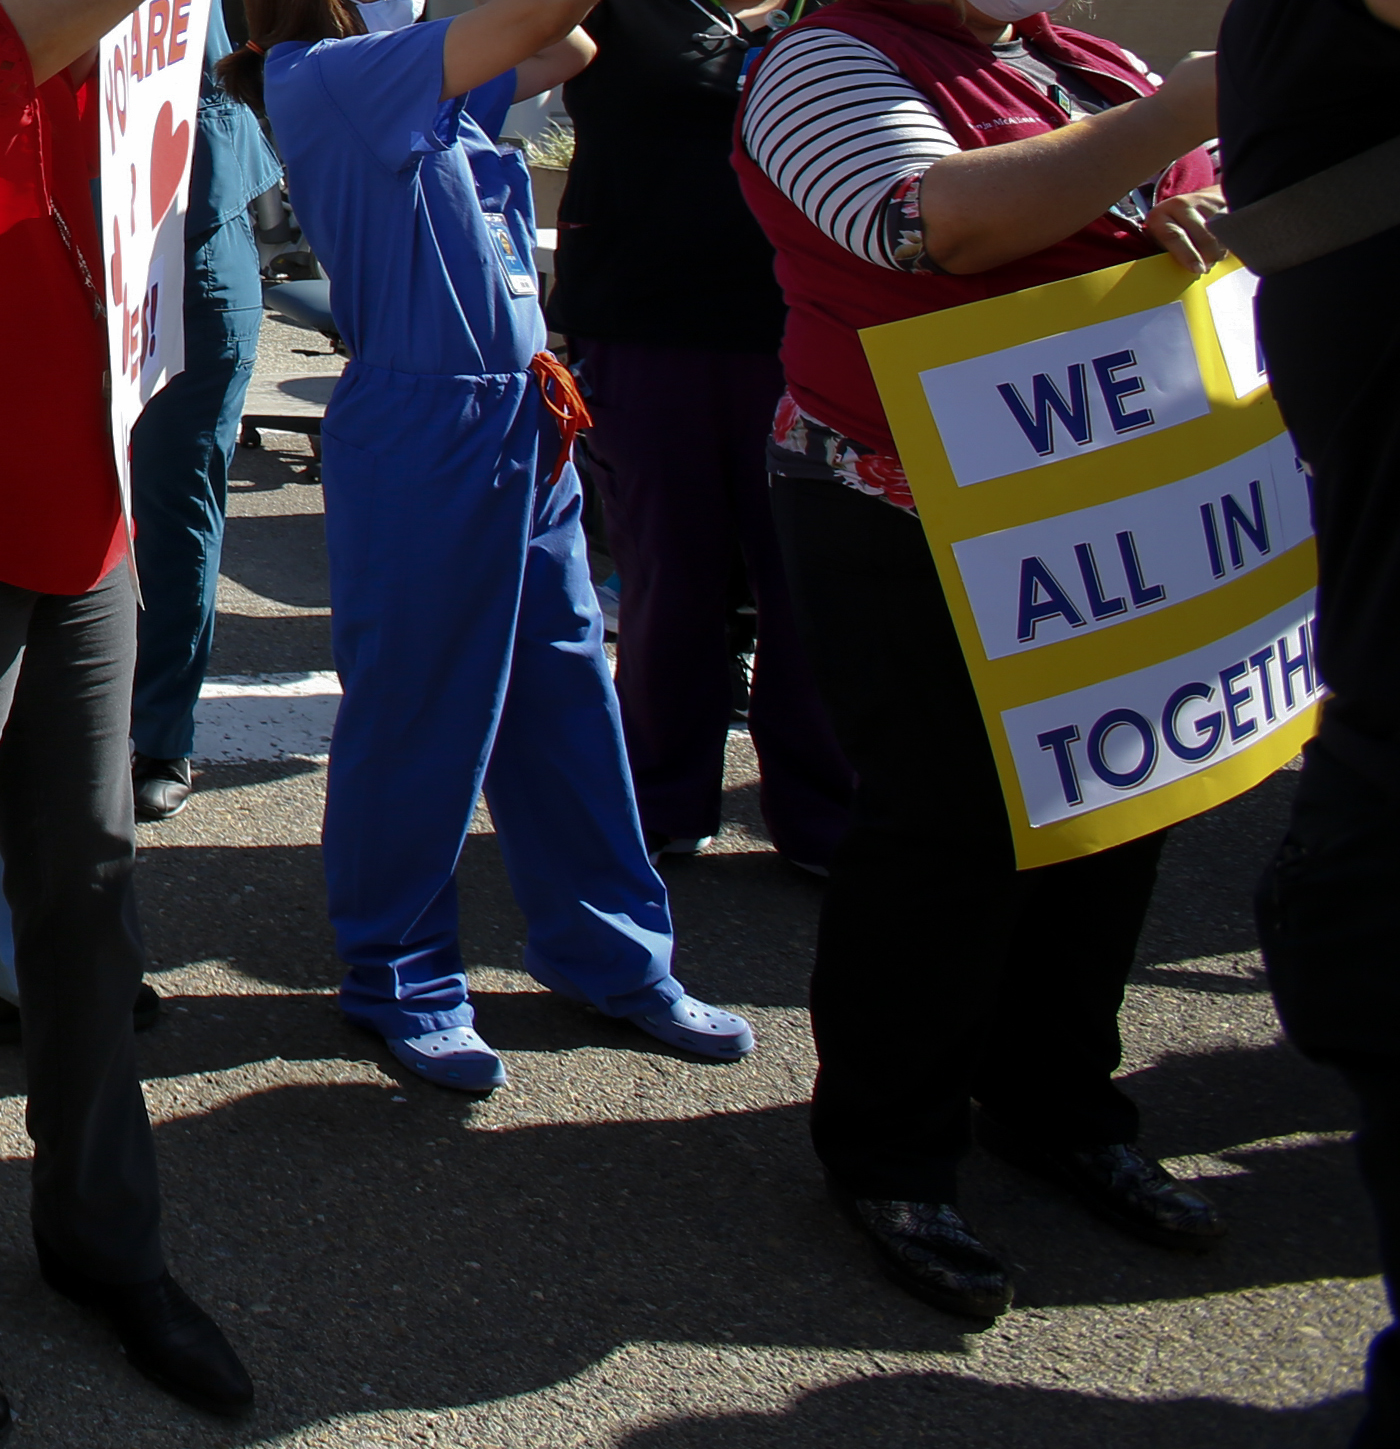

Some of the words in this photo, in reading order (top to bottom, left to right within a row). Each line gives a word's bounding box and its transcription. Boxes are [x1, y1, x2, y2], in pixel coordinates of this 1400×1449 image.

[996, 349, 1154, 457] WE
[1017, 530, 1166, 642] ALL
[1199, 480, 1271, 580] IN
